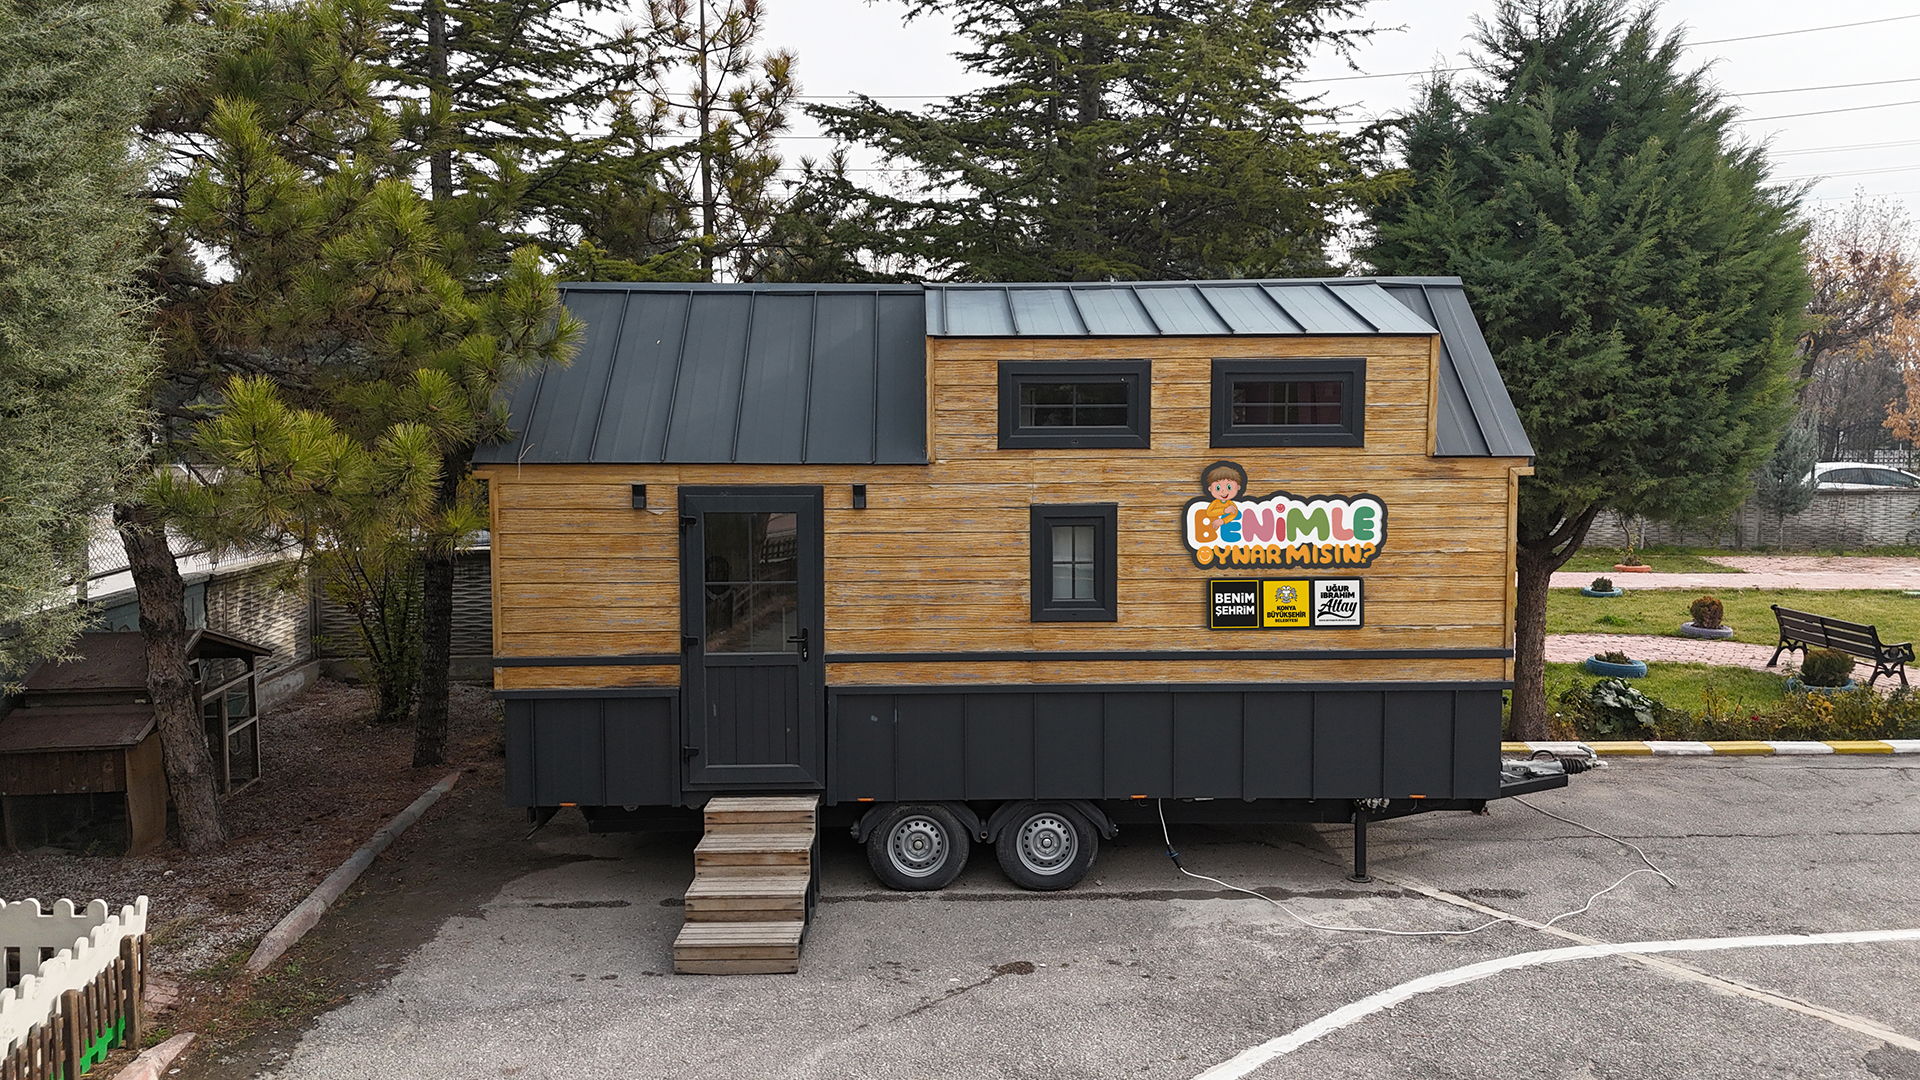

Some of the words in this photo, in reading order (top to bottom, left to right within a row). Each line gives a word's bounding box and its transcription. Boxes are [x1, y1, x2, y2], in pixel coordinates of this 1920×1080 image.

[1196, 543, 1282, 565] OYNAR
[1325, 584, 1350, 592] UĞUR
[1215, 592, 1255, 604] BENİM
[1215, 605, 1255, 617] ŞEHRİM
[1266, 610, 1307, 619] BÜYÜKŞEHİR
[1317, 598, 1358, 619] Altay
